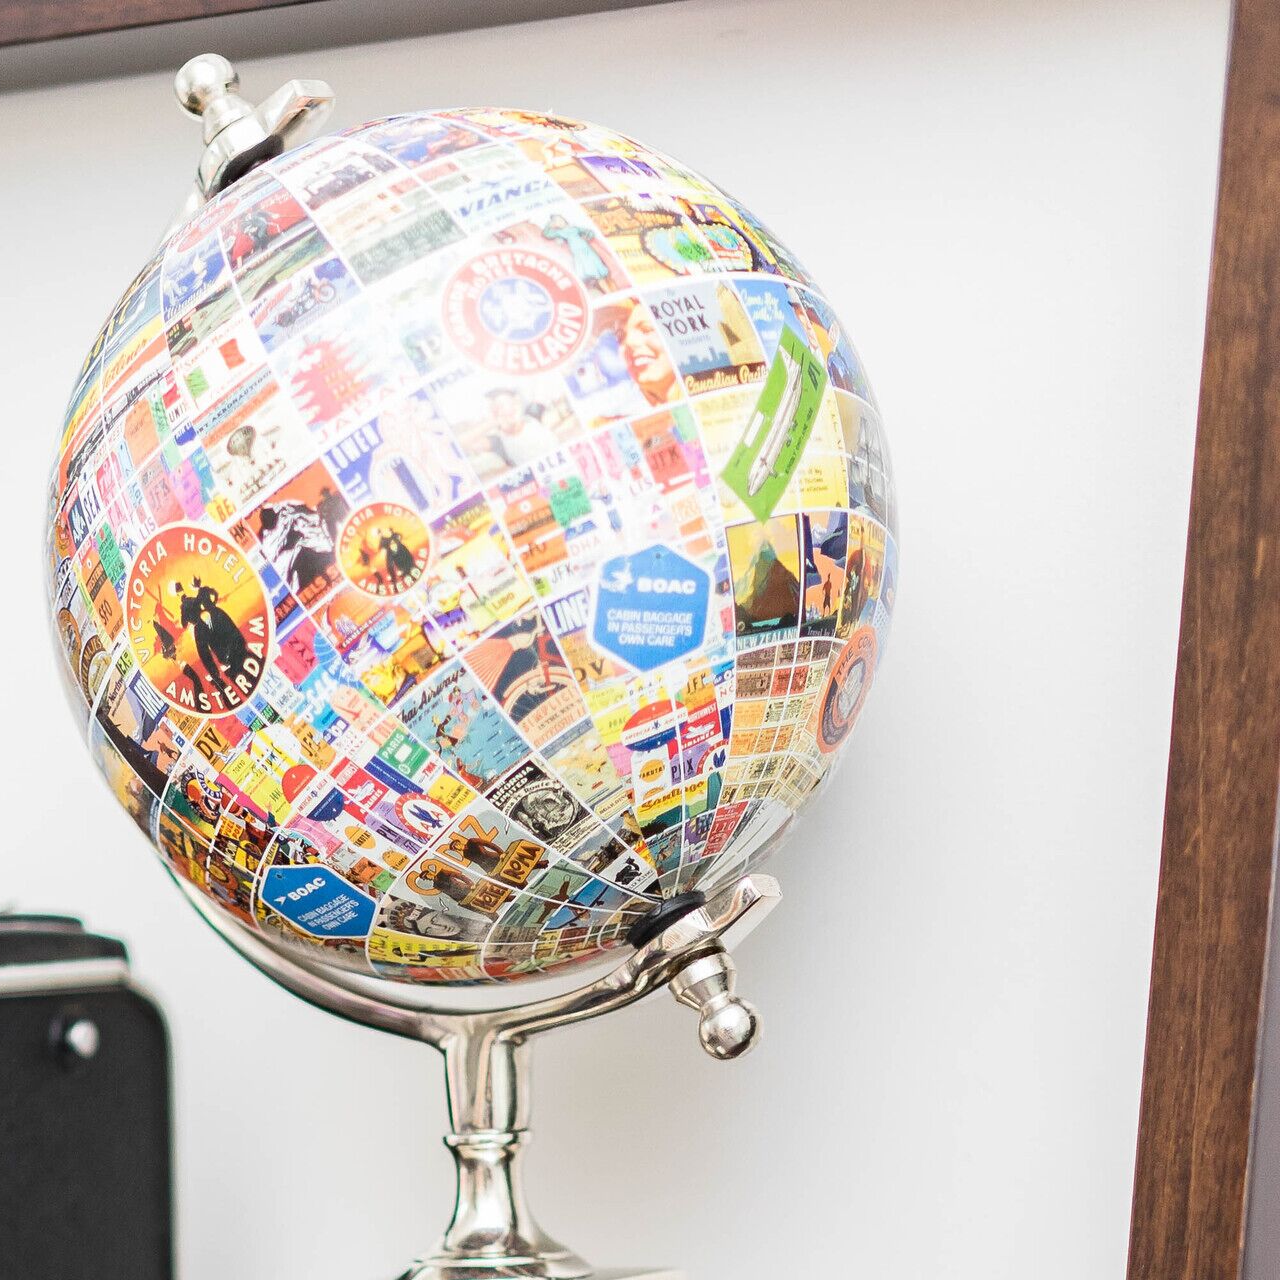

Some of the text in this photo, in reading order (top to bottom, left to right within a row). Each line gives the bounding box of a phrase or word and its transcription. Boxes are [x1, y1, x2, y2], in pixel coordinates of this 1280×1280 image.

[650, 293, 705, 320] ROYAL
[662, 313, 711, 338] YORK
[685, 371, 739, 394] Canadian
[130, 541, 168, 665] VICTORIA
[183, 532, 247, 584] HOTEL
[637, 578, 696, 595] BOAC
[607, 610, 694, 626] CABIN BAGGAGE
[608, 622, 621, 633] IN
[618, 633, 676, 647] OWN CARE
[737, 627, 799, 651] NEW ZEALAND
[165, 616, 265, 712] AMSTERDAM
[420, 665, 468, 708] Airways
[197, 727, 223, 760] DV
[381, 733, 406, 759] PARIS
[494, 778, 529, 807] LIMITED
[509, 844, 541, 877] ROMA
[291, 877, 327, 901] BOAC
[297, 893, 350, 923] CABIN BAGGAGE
[322, 910, 359, 931] OWN CARE
